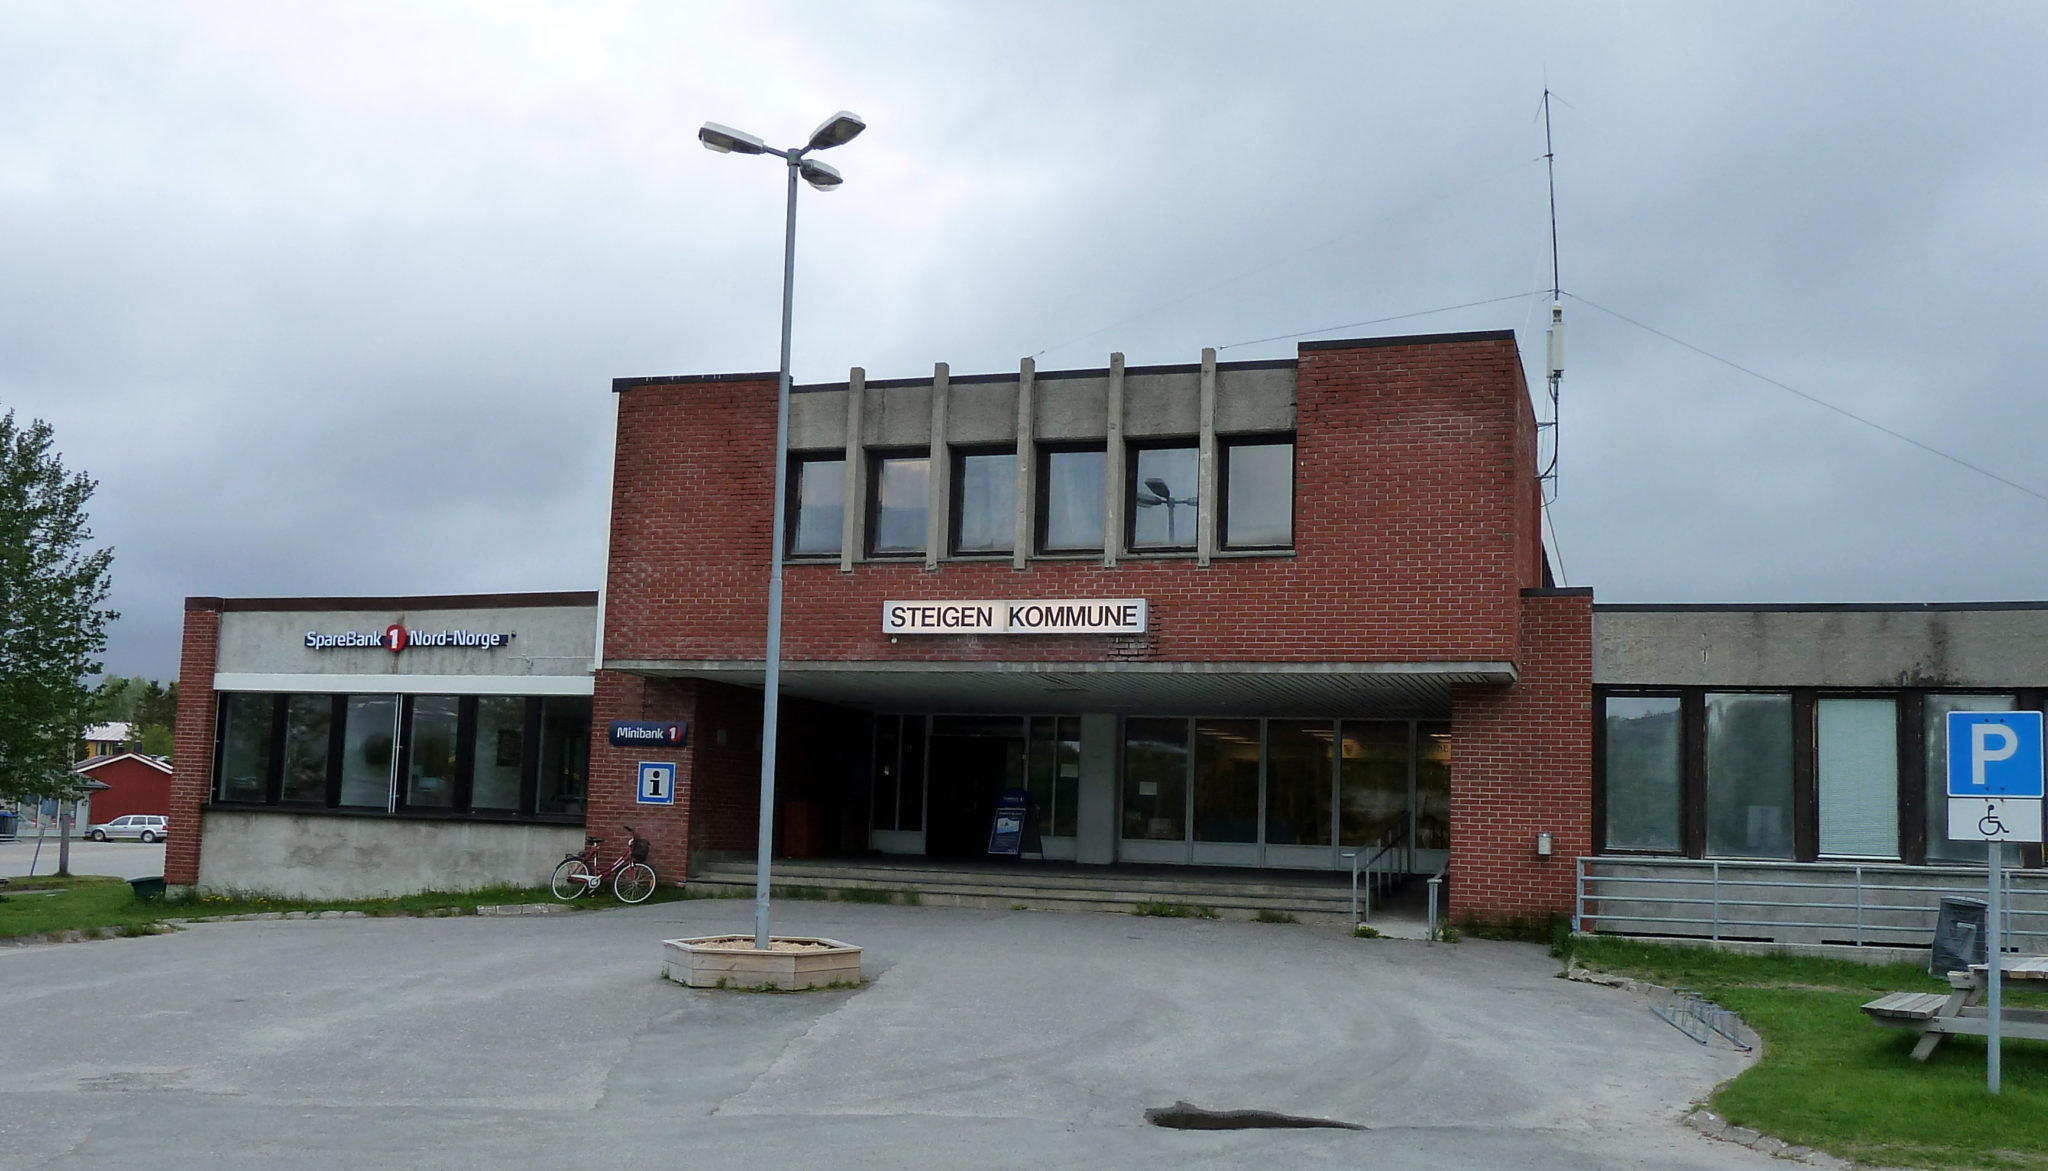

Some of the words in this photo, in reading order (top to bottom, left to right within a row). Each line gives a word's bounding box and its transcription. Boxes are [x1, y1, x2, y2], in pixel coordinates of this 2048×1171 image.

[890, 606, 993, 628] STEIGEN
[1008, 605, 1138, 627] KOMMUNE
[306, 630, 382, 649] SpareBank
[389, 629, 399, 649] 1
[409, 629, 501, 649] Nord-Norge
[616, 727, 664, 739] Minibank
[669, 727, 677, 741] 1
[1971, 723, 2018, 785] P
[648, 770, 662, 796] i
